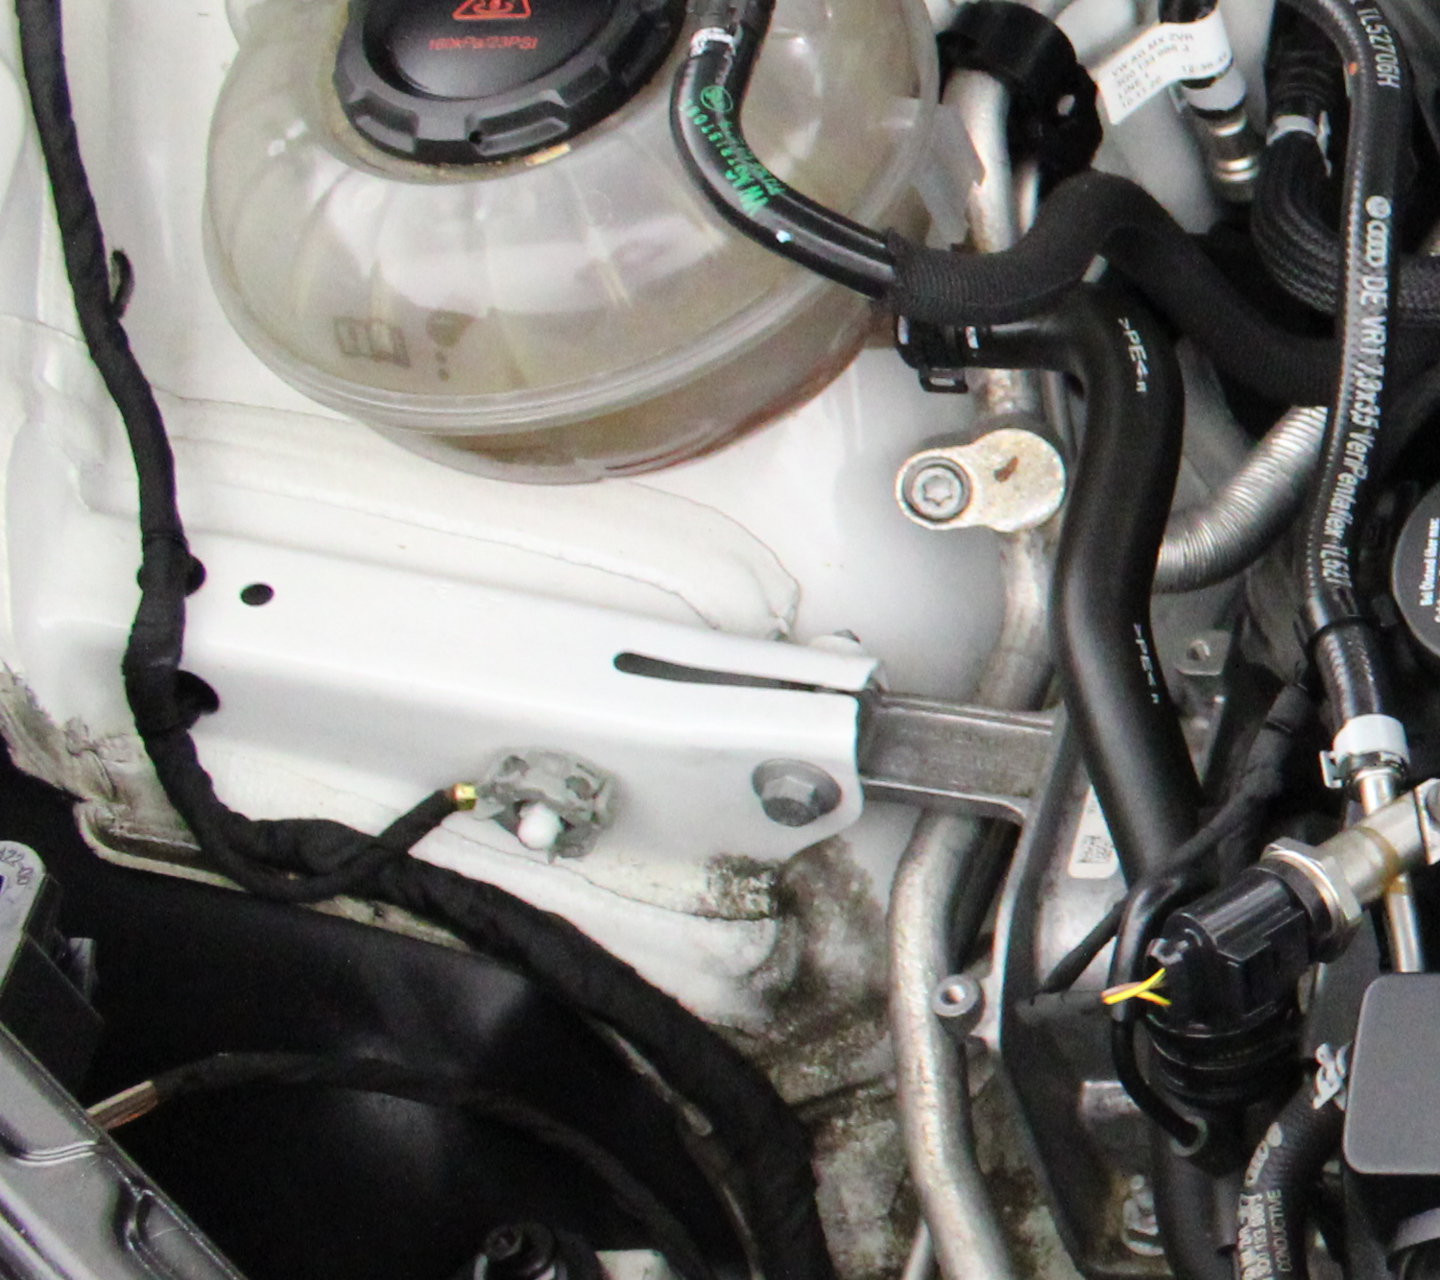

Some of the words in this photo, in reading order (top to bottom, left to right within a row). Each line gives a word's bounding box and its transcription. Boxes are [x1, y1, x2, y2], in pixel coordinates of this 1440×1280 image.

[1360, 276, 1388, 306] DE
[1359, 315, 1388, 354] VRT
[1266, 1189, 1292, 1272] CONDUCTIVE
